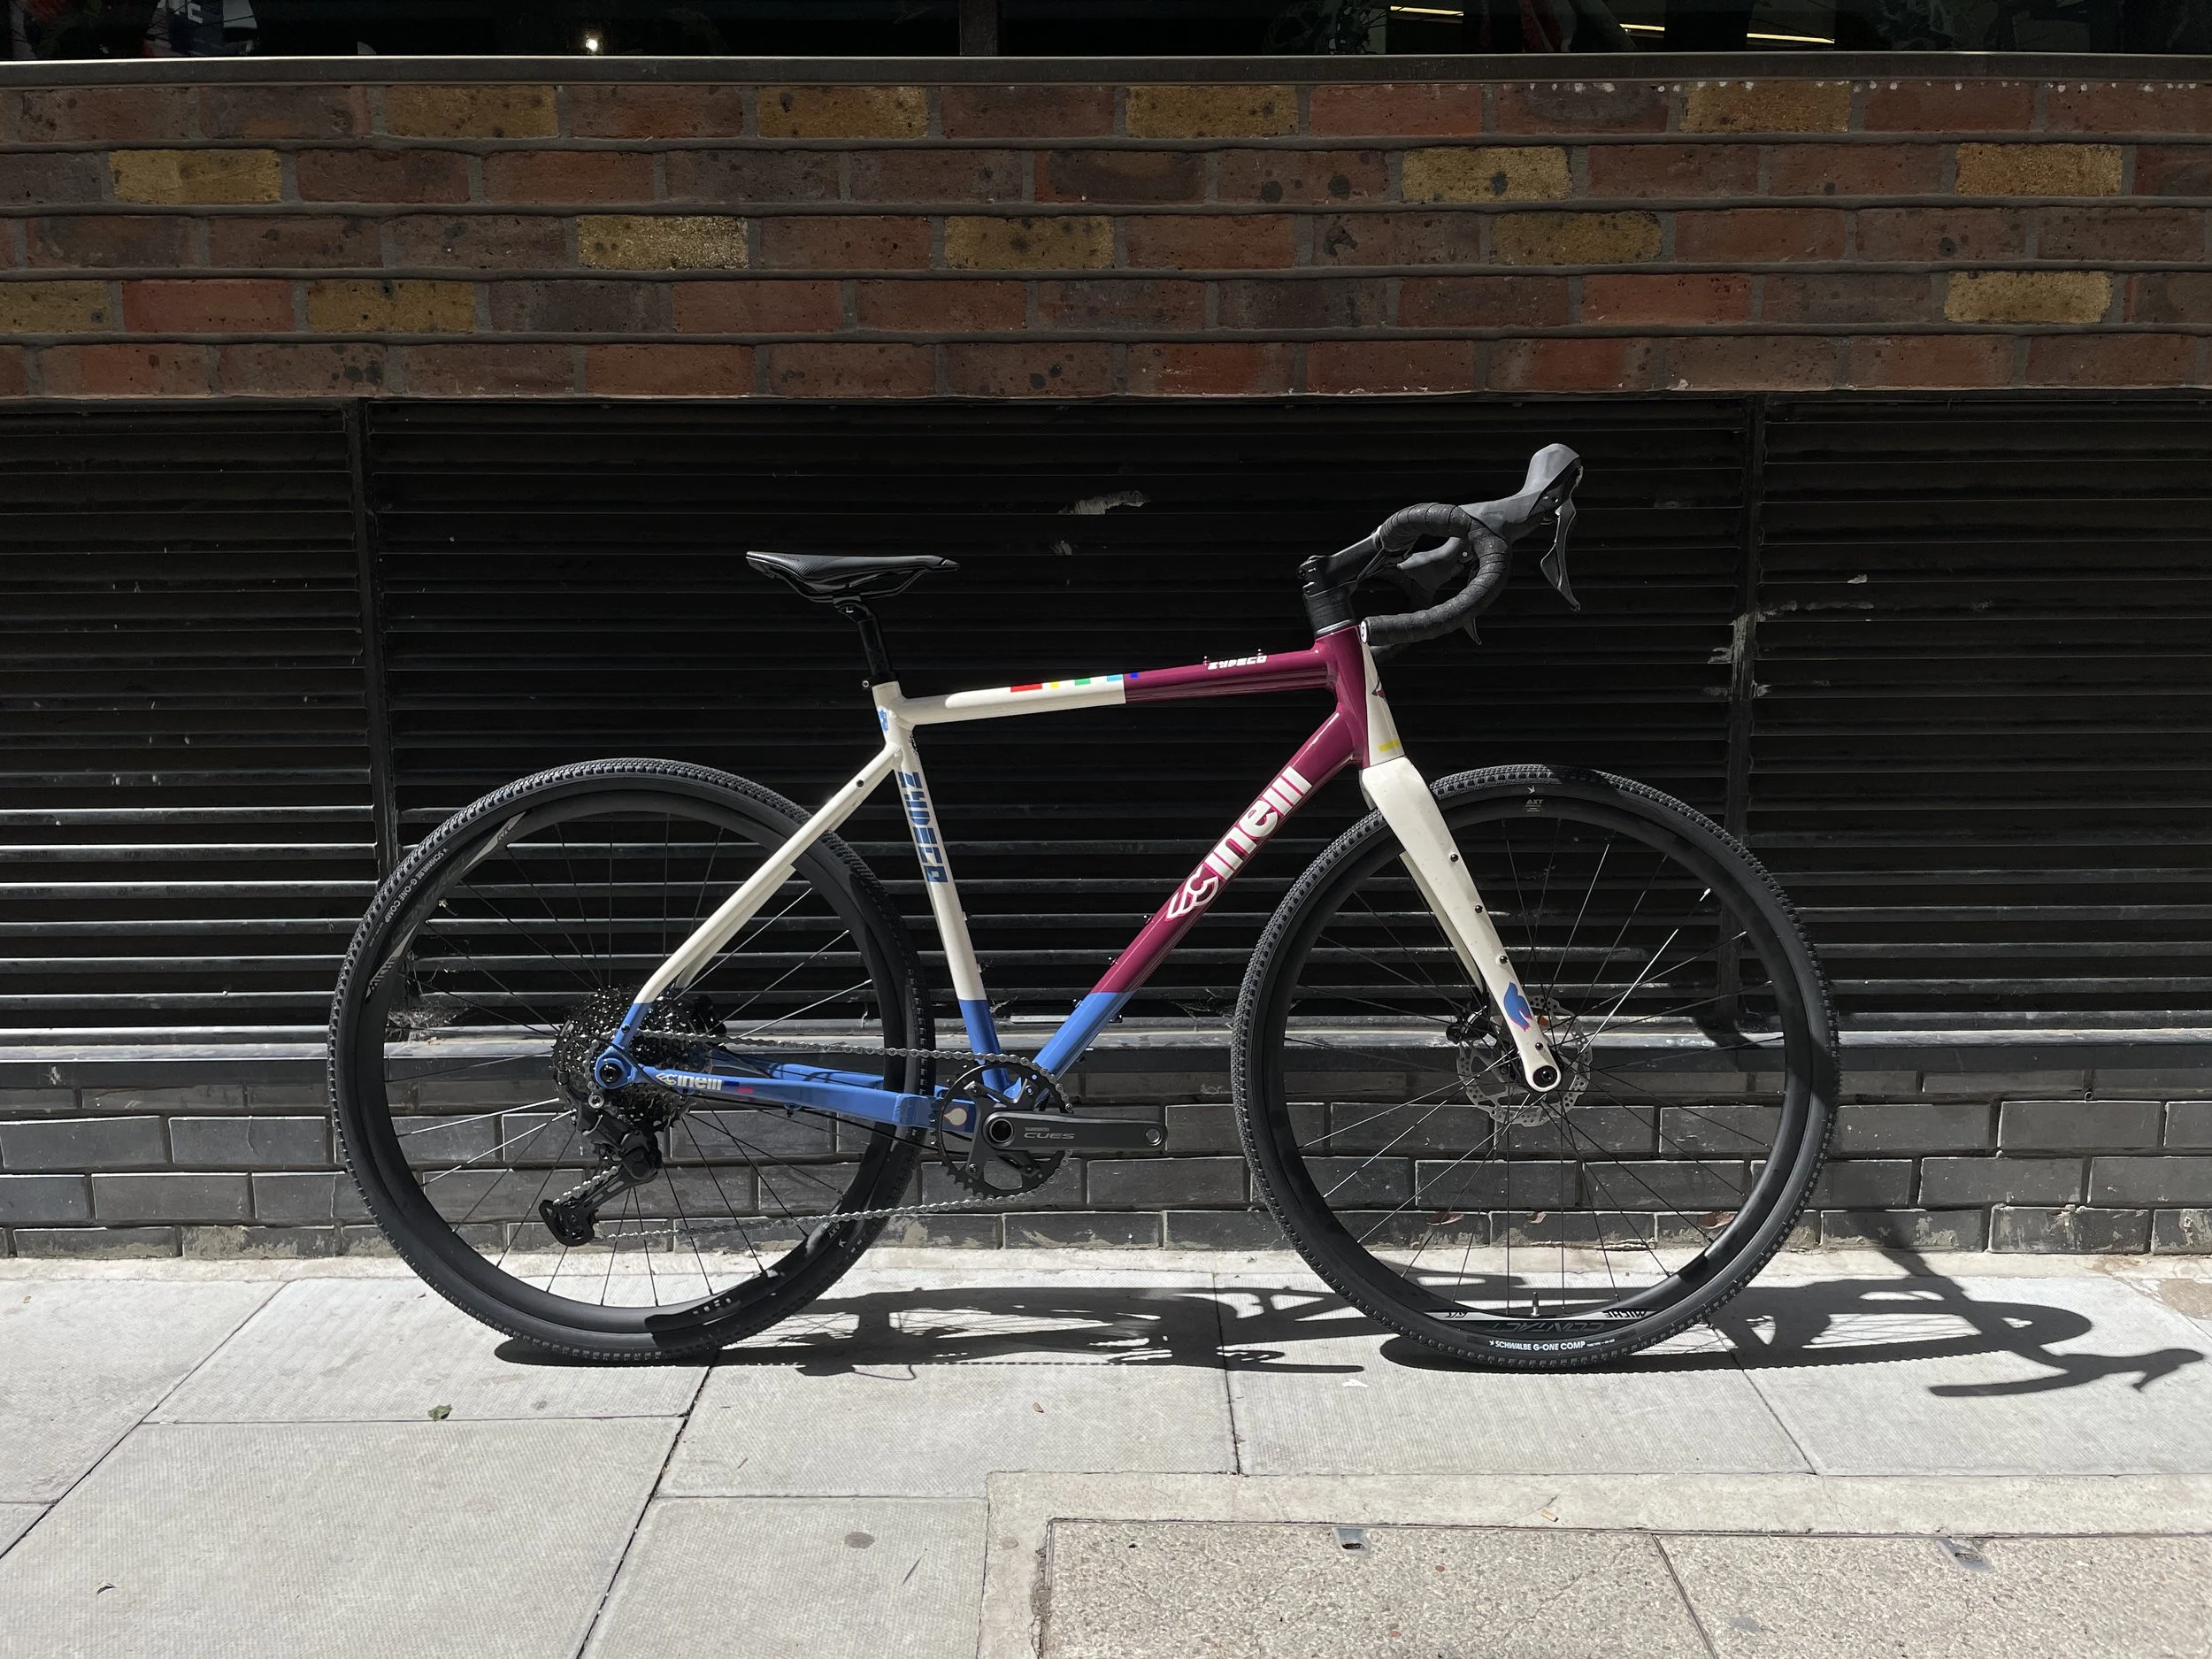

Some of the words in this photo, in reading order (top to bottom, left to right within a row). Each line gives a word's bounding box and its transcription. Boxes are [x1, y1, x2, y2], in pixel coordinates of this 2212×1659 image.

[1207, 655, 1267, 670] ZYDECO
[898, 772, 949, 883] ZYDECO
[415, 850, 444, 879] SCHWALBE
[398, 878, 418, 902] G-ONE
[384, 900, 401, 923] COMP
[1495, 1340, 1532, 1351] SCHWALBE
[1560, 1340, 1586, 1350] COMP
